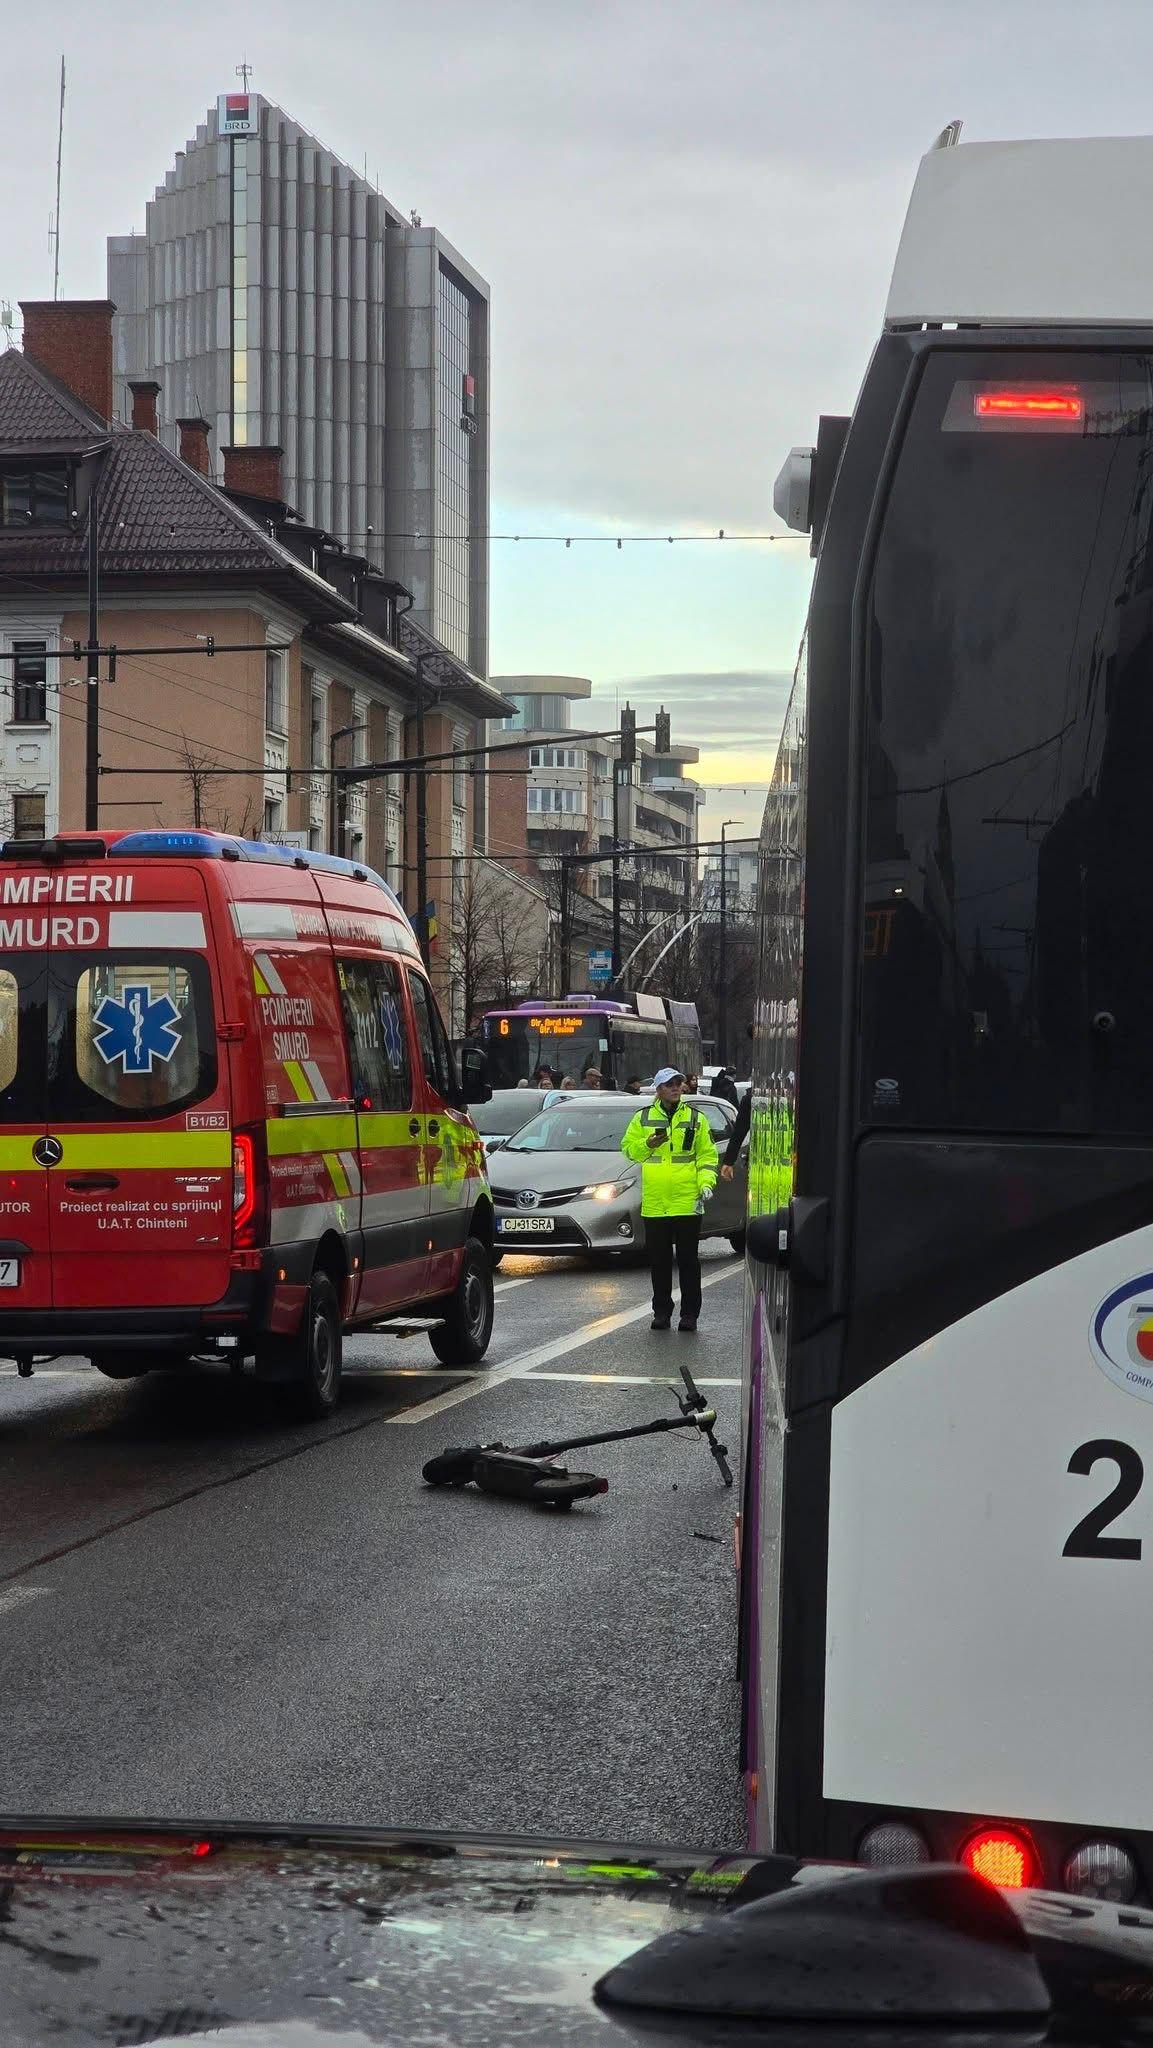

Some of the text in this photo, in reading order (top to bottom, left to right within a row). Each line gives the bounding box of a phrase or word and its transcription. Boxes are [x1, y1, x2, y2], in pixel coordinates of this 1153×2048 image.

[224, 121, 250, 129] BRD
[0, 875, 133, 904] MPIERII
[261, 997, 315, 1026] POMPIERII
[500, 1019, 509, 1035] 6
[272, 1031, 310, 1060] SMURD
[190, 1116, 225, 1127] B1/B2
[60, 1202, 103, 1213] Proiect
[106, 1200, 150, 1212] realizat
[153, 1203, 168, 1211] cu
[98, 1217, 188, 1229] U.A.T. Chinteni
[1062, 1438, 1145, 1561] 2
